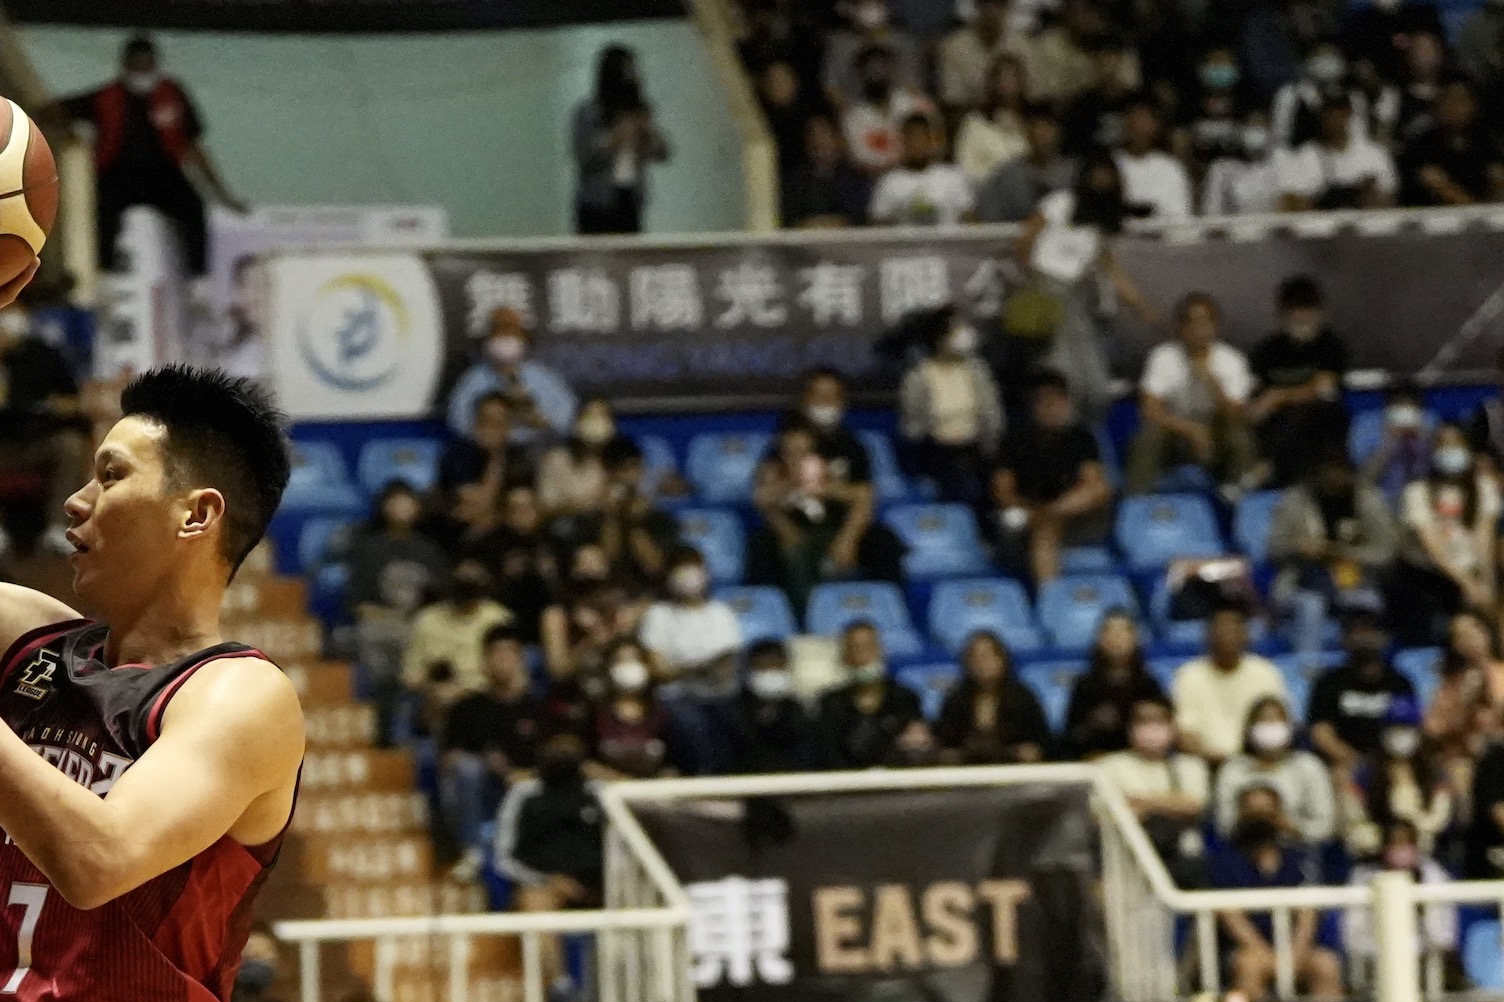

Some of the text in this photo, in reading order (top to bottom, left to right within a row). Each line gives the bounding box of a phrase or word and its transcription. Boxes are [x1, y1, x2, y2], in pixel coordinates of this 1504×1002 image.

[0, 881, 50, 995] 7
[686, 874, 1033, 988] 東 EAST
